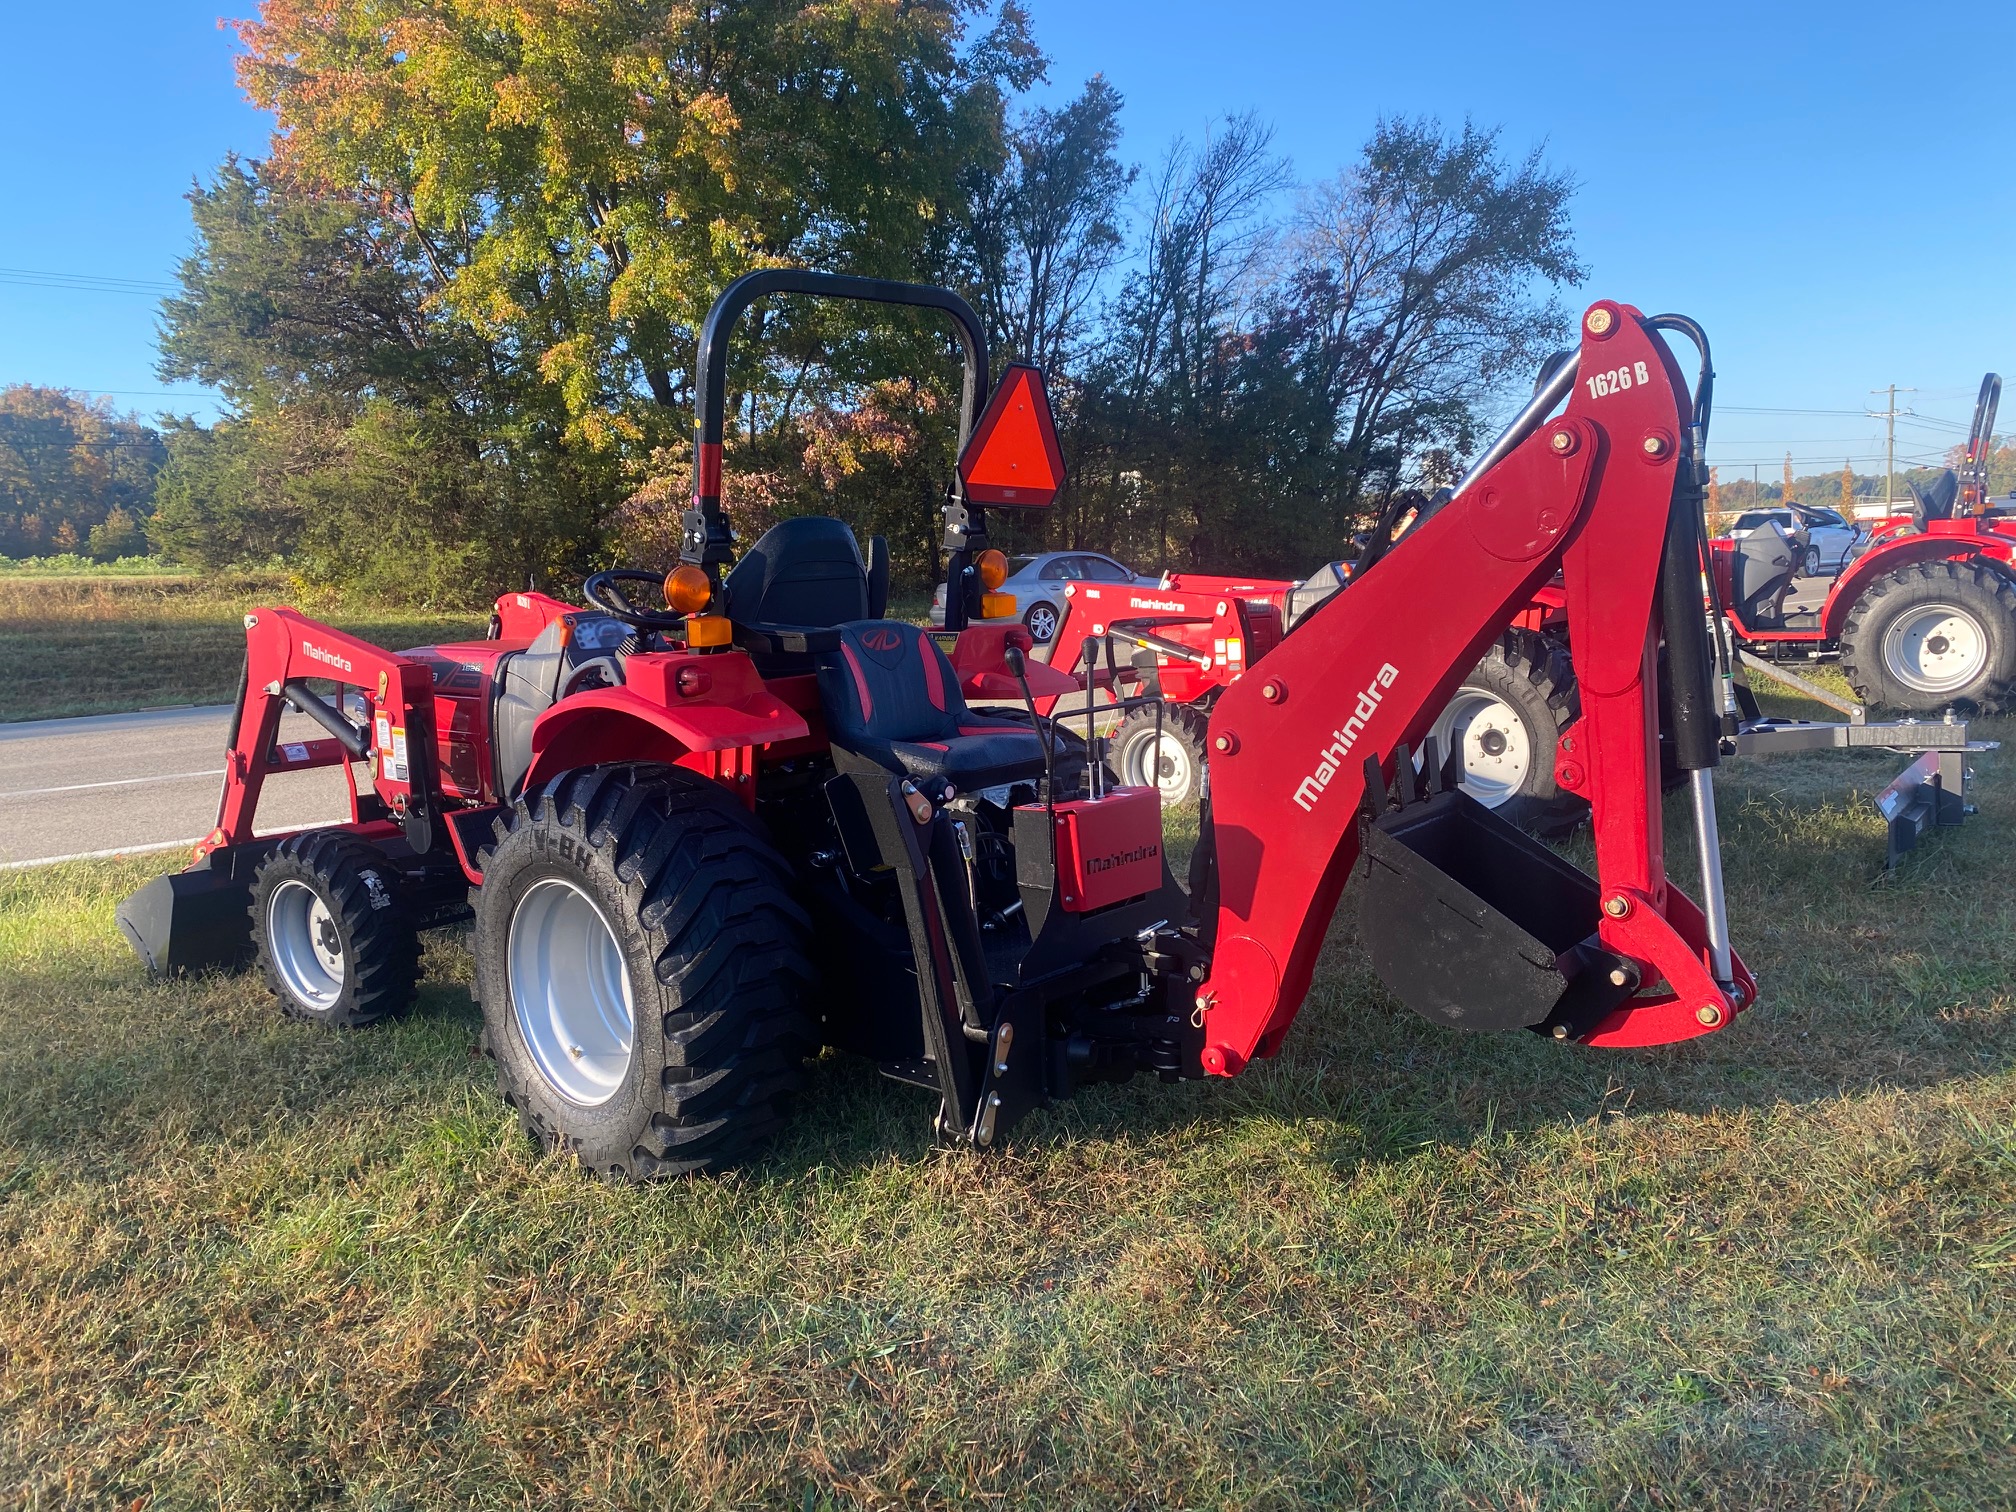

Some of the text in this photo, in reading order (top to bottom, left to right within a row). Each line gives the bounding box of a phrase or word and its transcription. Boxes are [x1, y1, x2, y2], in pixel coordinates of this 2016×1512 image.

[1586, 361, 1649, 400] 1626 B
[1130, 597, 1185, 612] Mahindra
[303, 640, 352, 673] Mahindra
[1292, 662, 1400, 813] Mahindra
[1086, 845, 1158, 876] Mahindra
